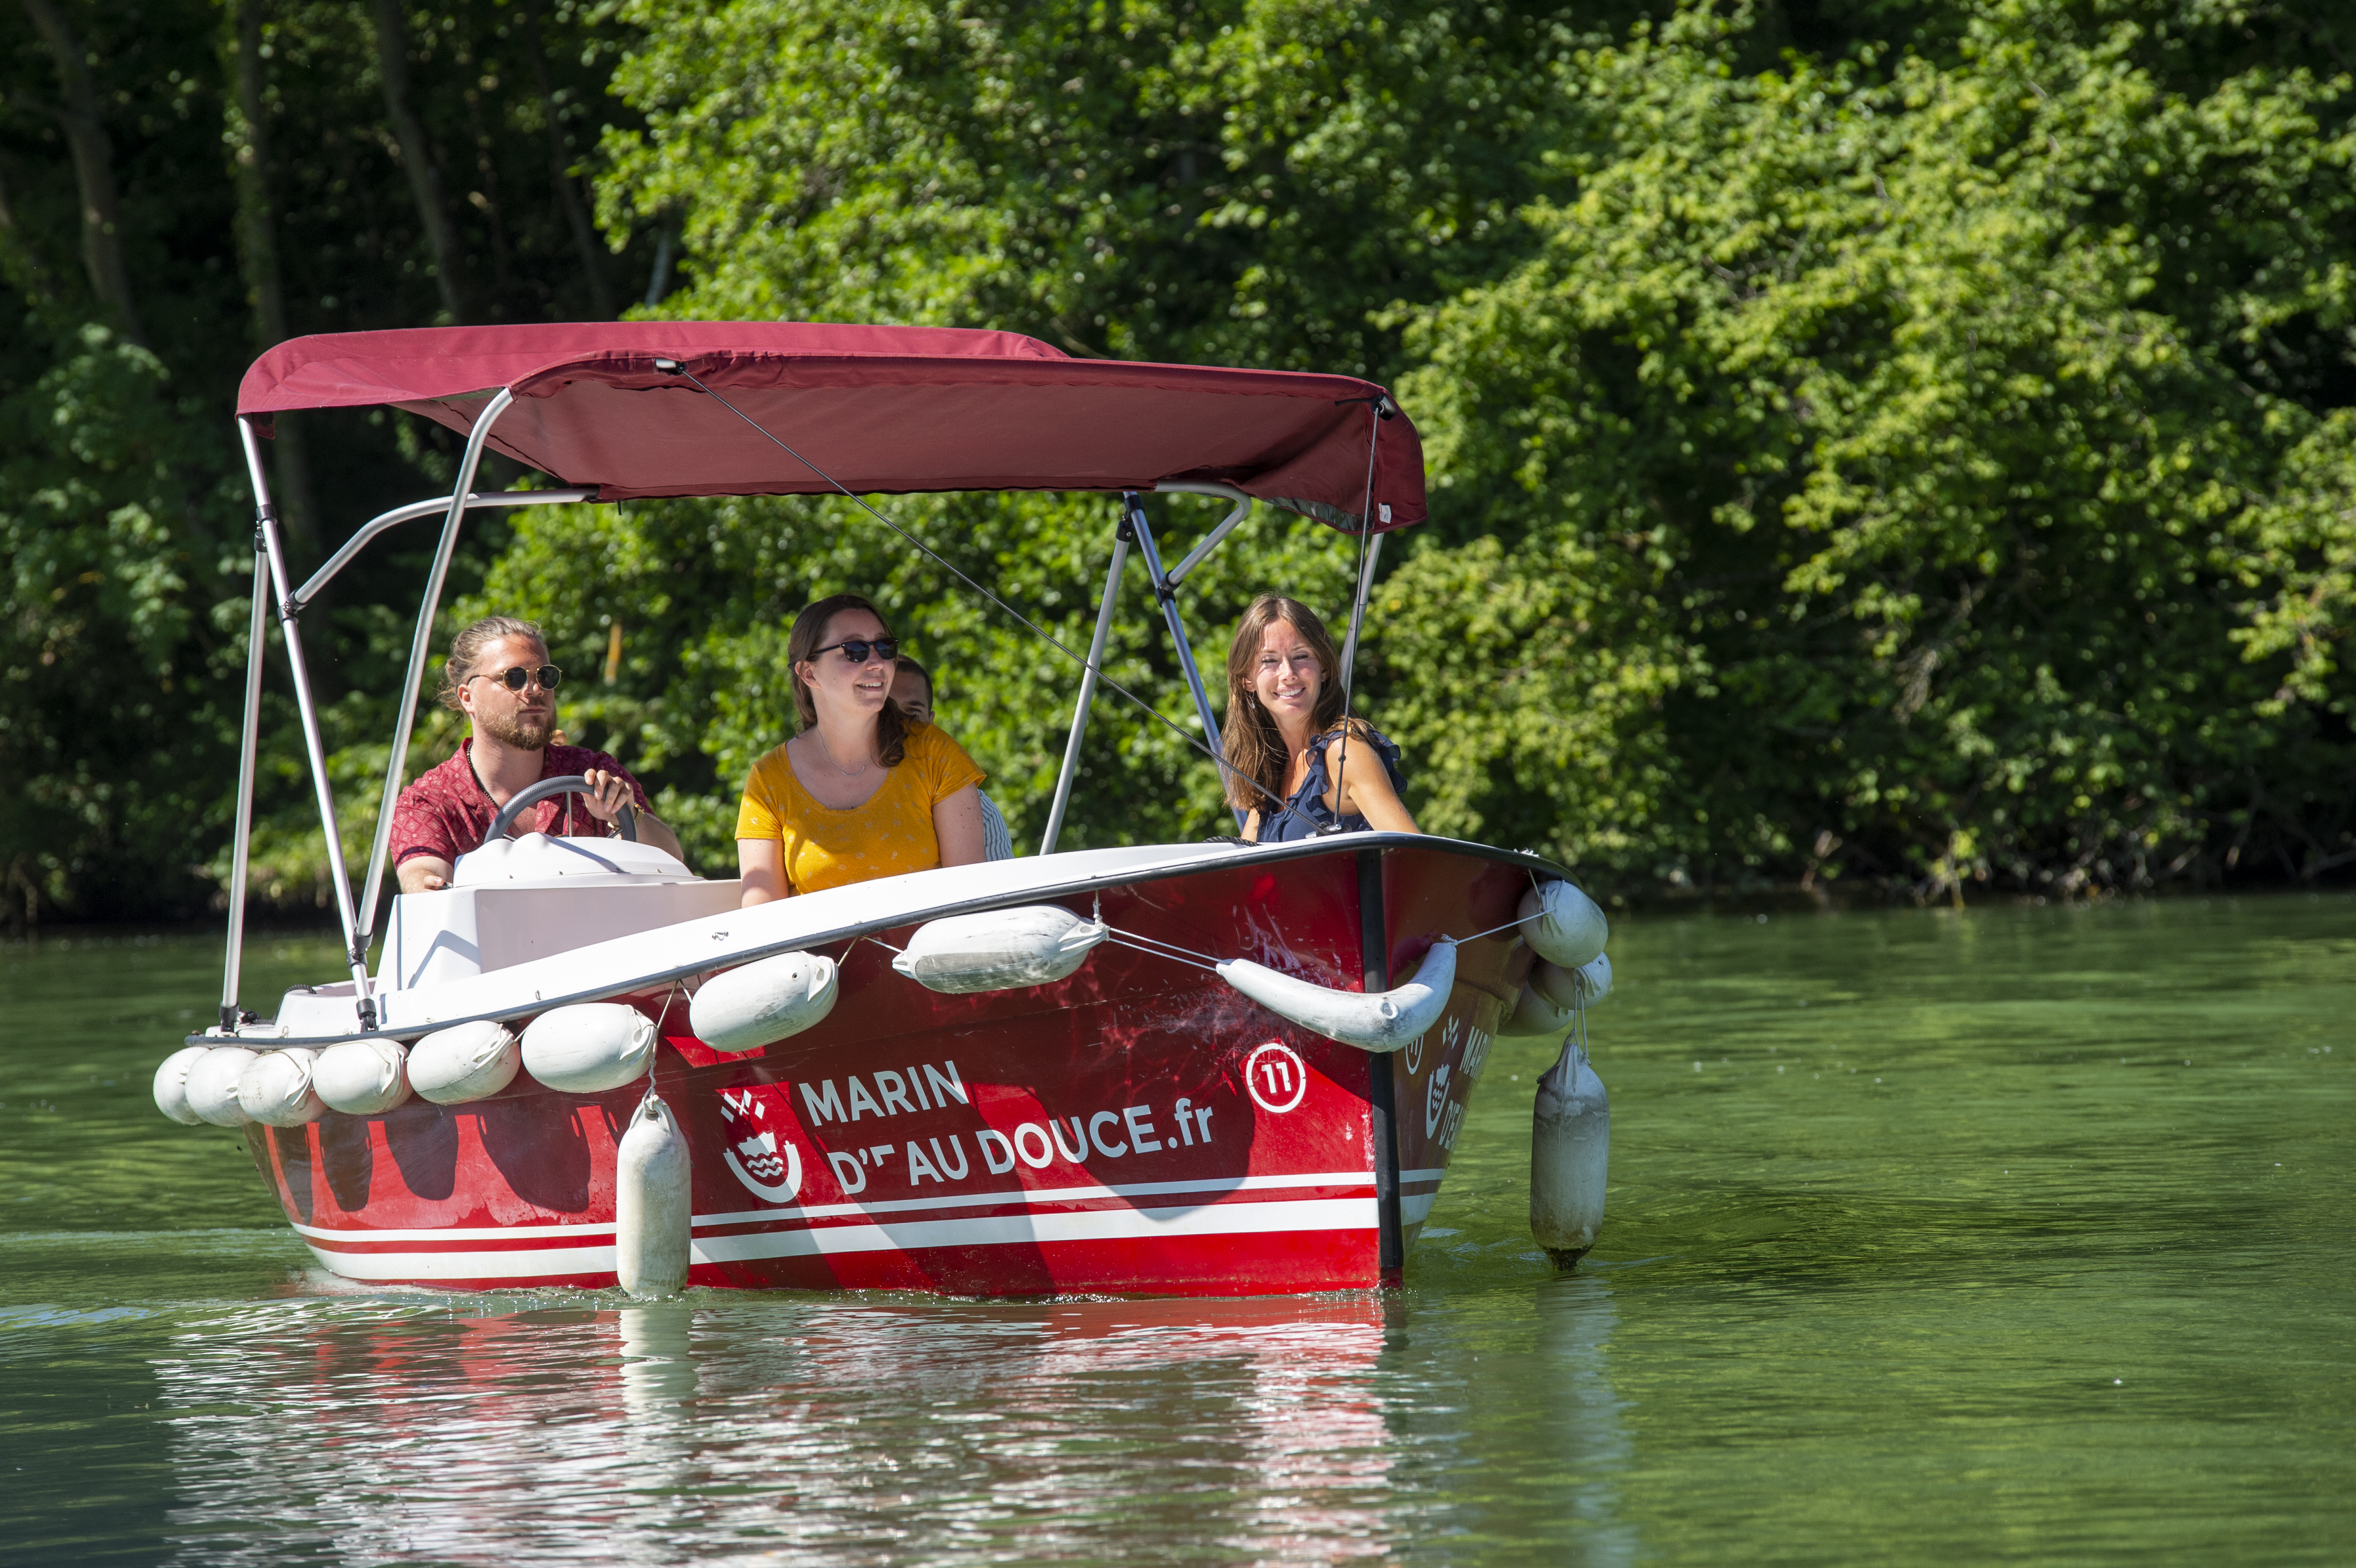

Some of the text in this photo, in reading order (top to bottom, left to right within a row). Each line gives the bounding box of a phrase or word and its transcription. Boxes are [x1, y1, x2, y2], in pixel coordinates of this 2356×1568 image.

[798, 1060, 969, 1126] MARIN
[1261, 1062, 1291, 1093] 11
[975, 1098, 1213, 1175] DOUCE.fr
